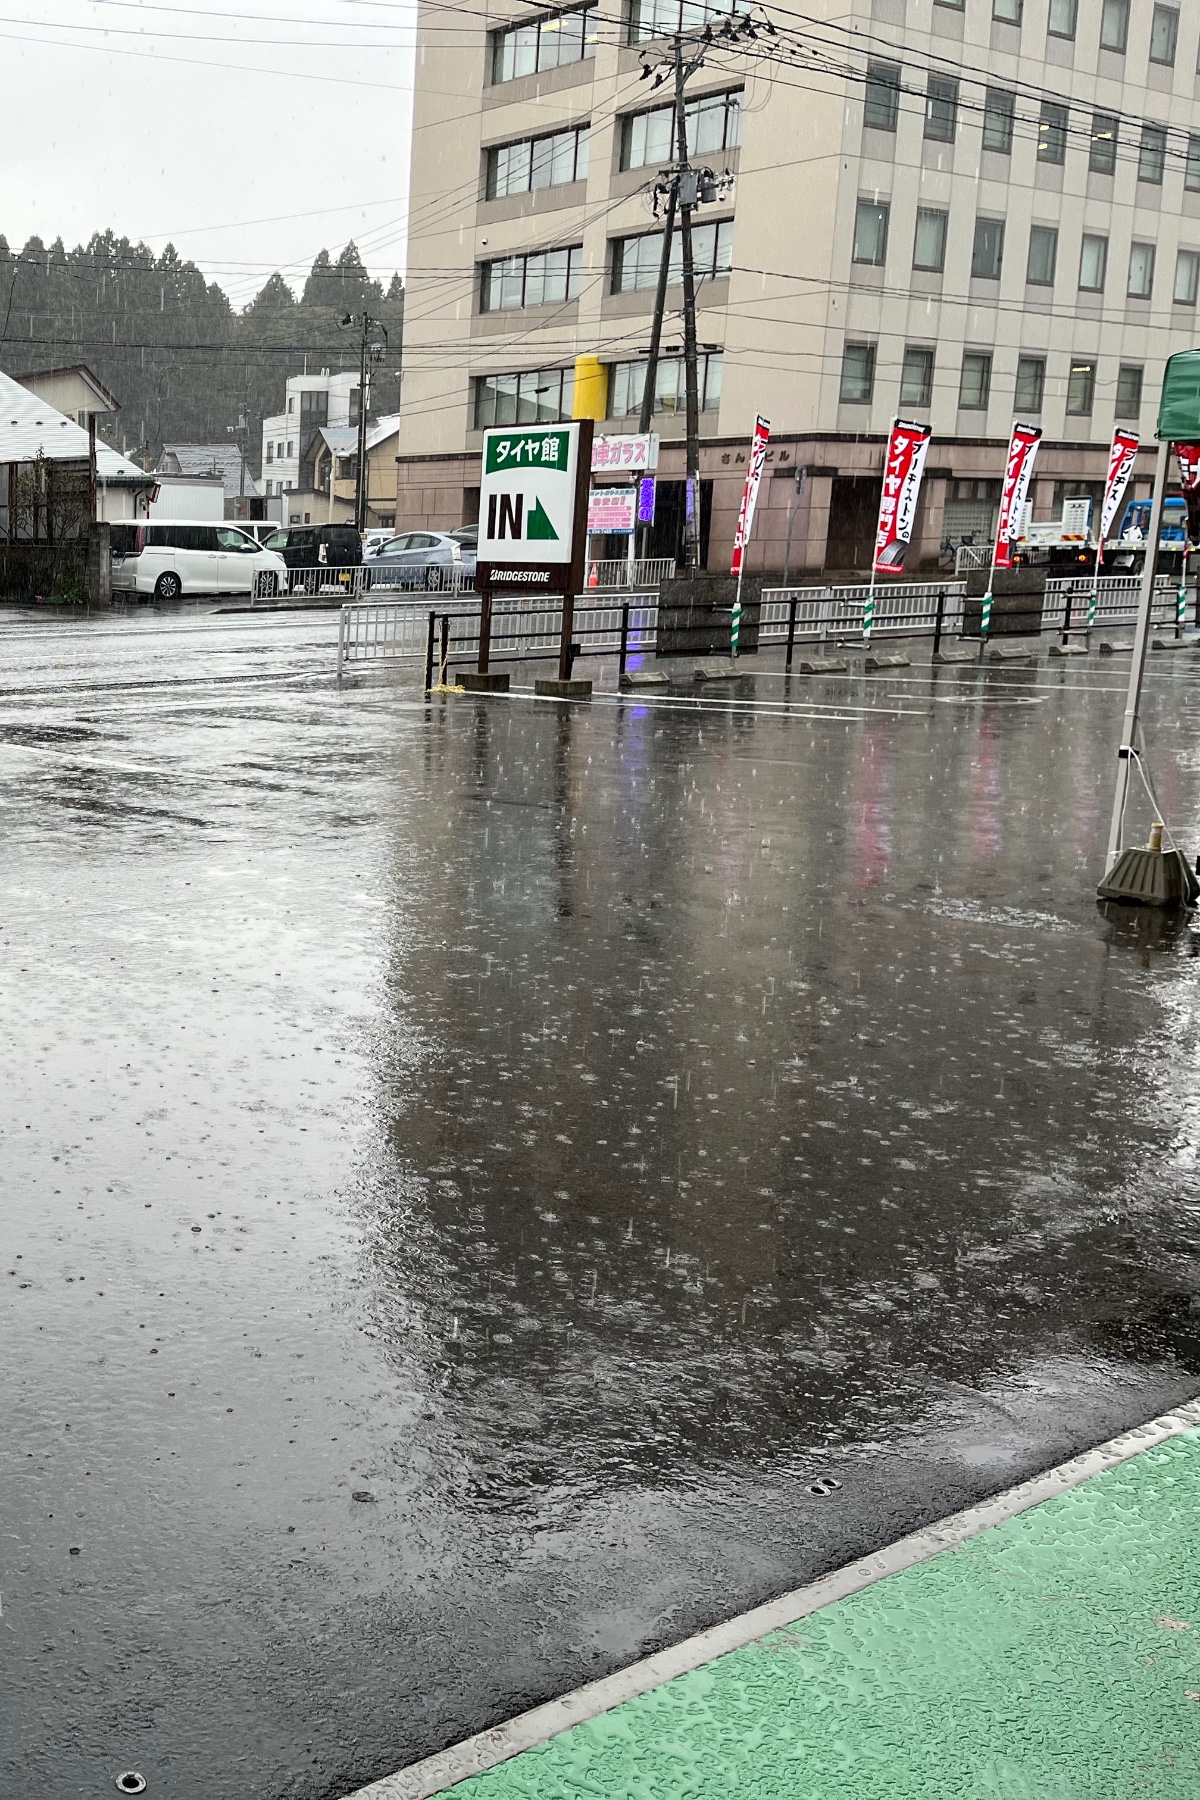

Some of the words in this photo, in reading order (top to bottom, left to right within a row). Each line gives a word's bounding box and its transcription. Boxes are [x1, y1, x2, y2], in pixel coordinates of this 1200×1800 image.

[496, 437, 560, 464] タイヤ館
[486, 493, 524, 540] IN
[489, 569, 551, 583] BRIDGESTONE
